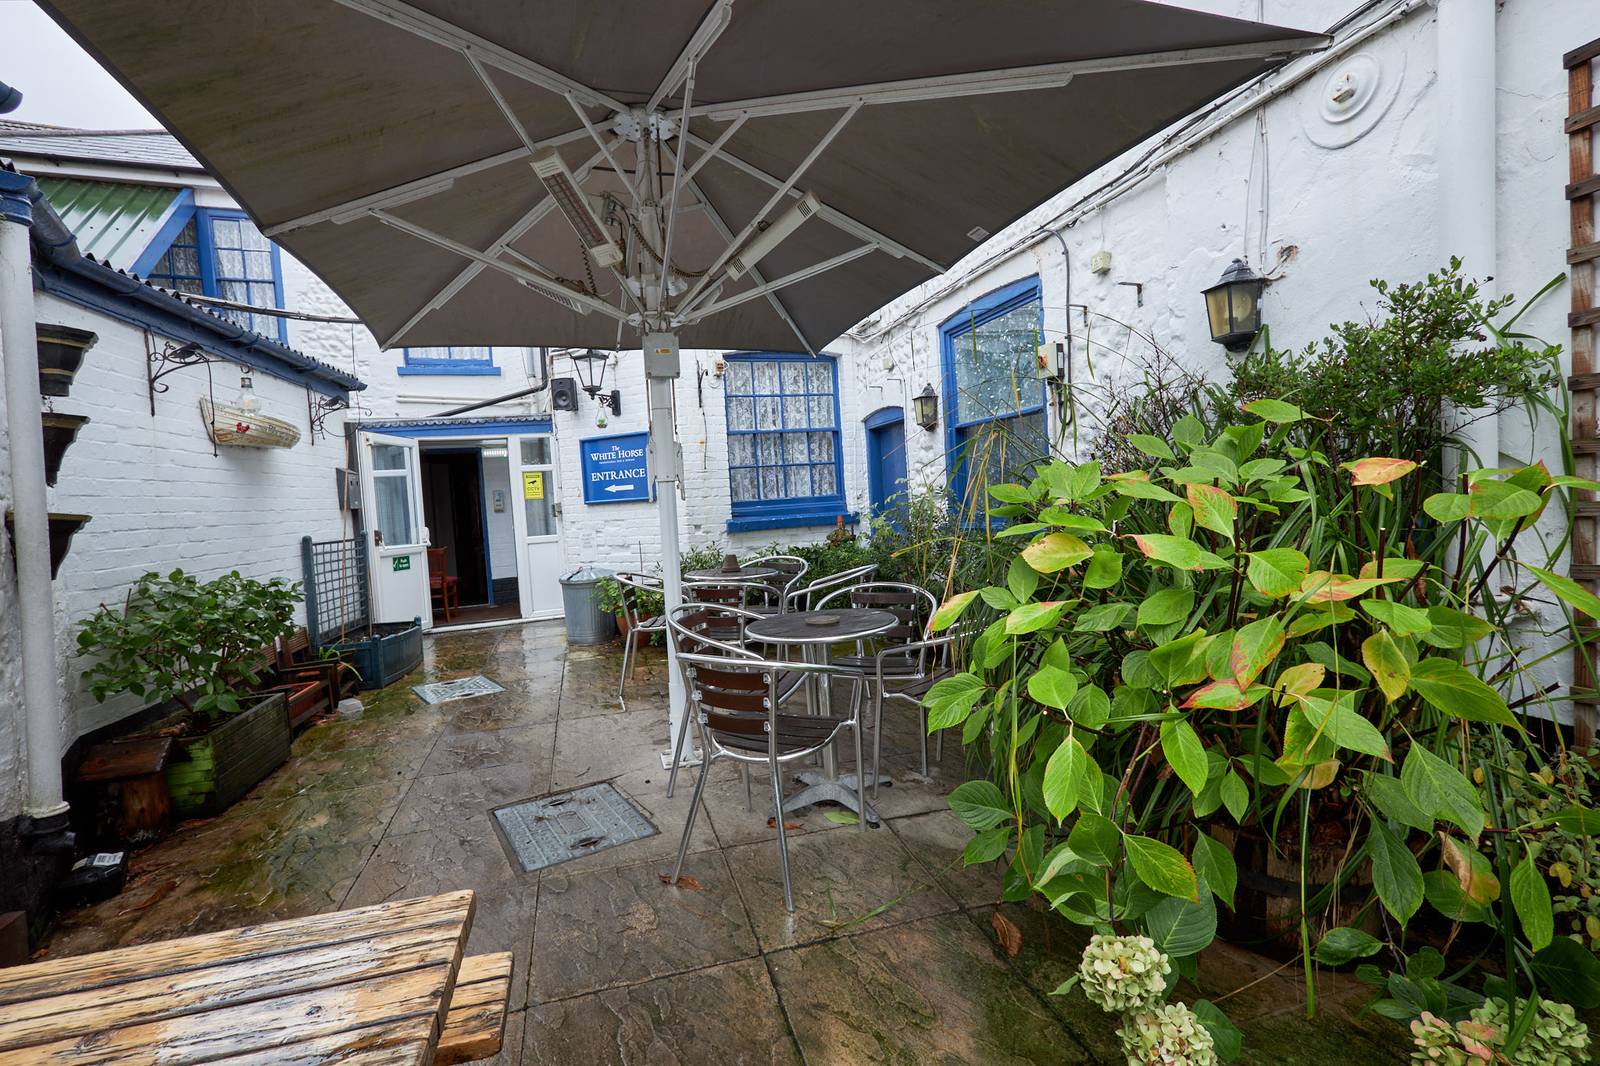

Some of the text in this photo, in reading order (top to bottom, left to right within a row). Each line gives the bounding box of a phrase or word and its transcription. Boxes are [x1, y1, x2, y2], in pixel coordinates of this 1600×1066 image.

[590, 448, 644, 461] WHITE HORSE
[591, 468, 646, 482] ENTRANCE
